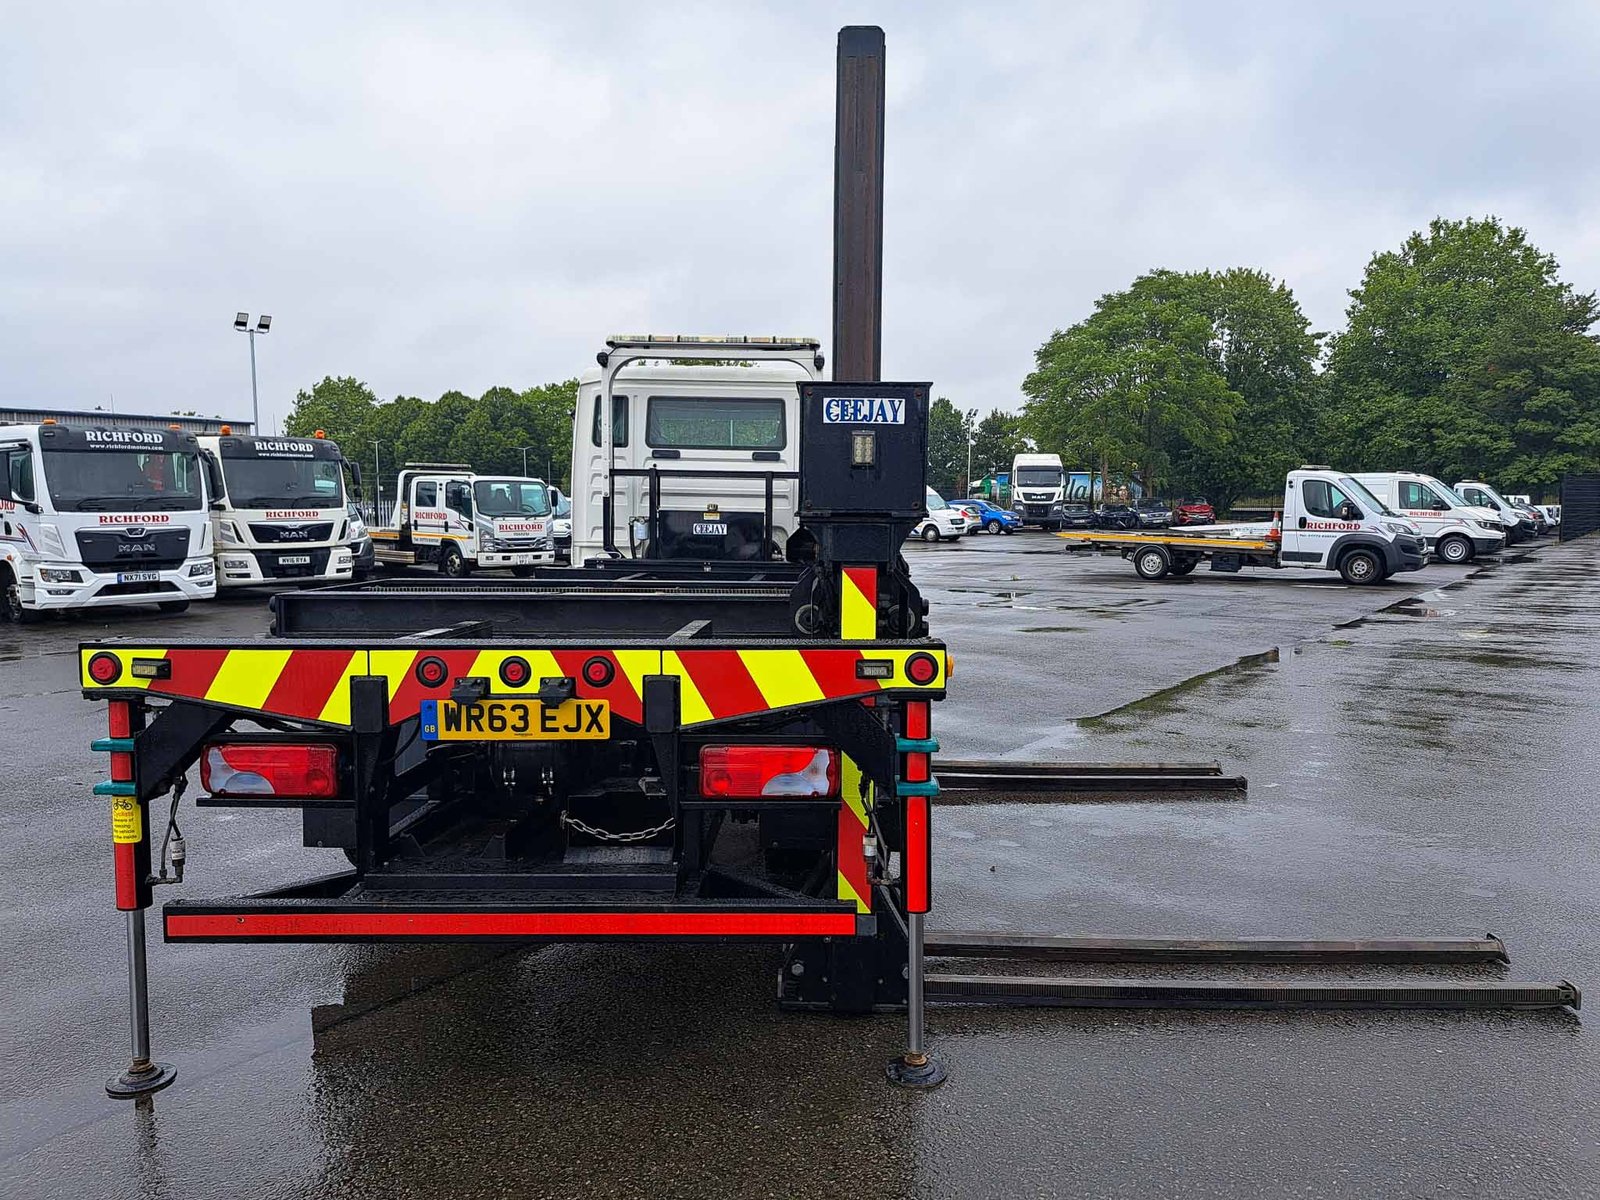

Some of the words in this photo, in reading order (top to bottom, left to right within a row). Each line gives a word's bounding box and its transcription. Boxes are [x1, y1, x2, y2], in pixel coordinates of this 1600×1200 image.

[825, 398, 903, 423] CEEJAY
[85, 430, 163, 444] RICHFORD
[89, 443, 164, 451] www.richfordmotors.com
[254, 441, 314, 452] RICHFORD
[99, 514, 170, 523] RICHFORD
[265, 510, 319, 518] RICHFORD
[415, 511, 448, 520] RICHFORD
[498, 523, 543, 531] RICHFORD
[694, 523, 726, 534] CEEJAY
[1307, 521, 1361, 531] RICHFORD
[280, 530, 308, 539] MAN
[118, 543, 156, 553] MAN
[443, 702, 530, 733] WR63
[540, 703, 604, 733] EJX
[424, 725, 436, 733] GB
